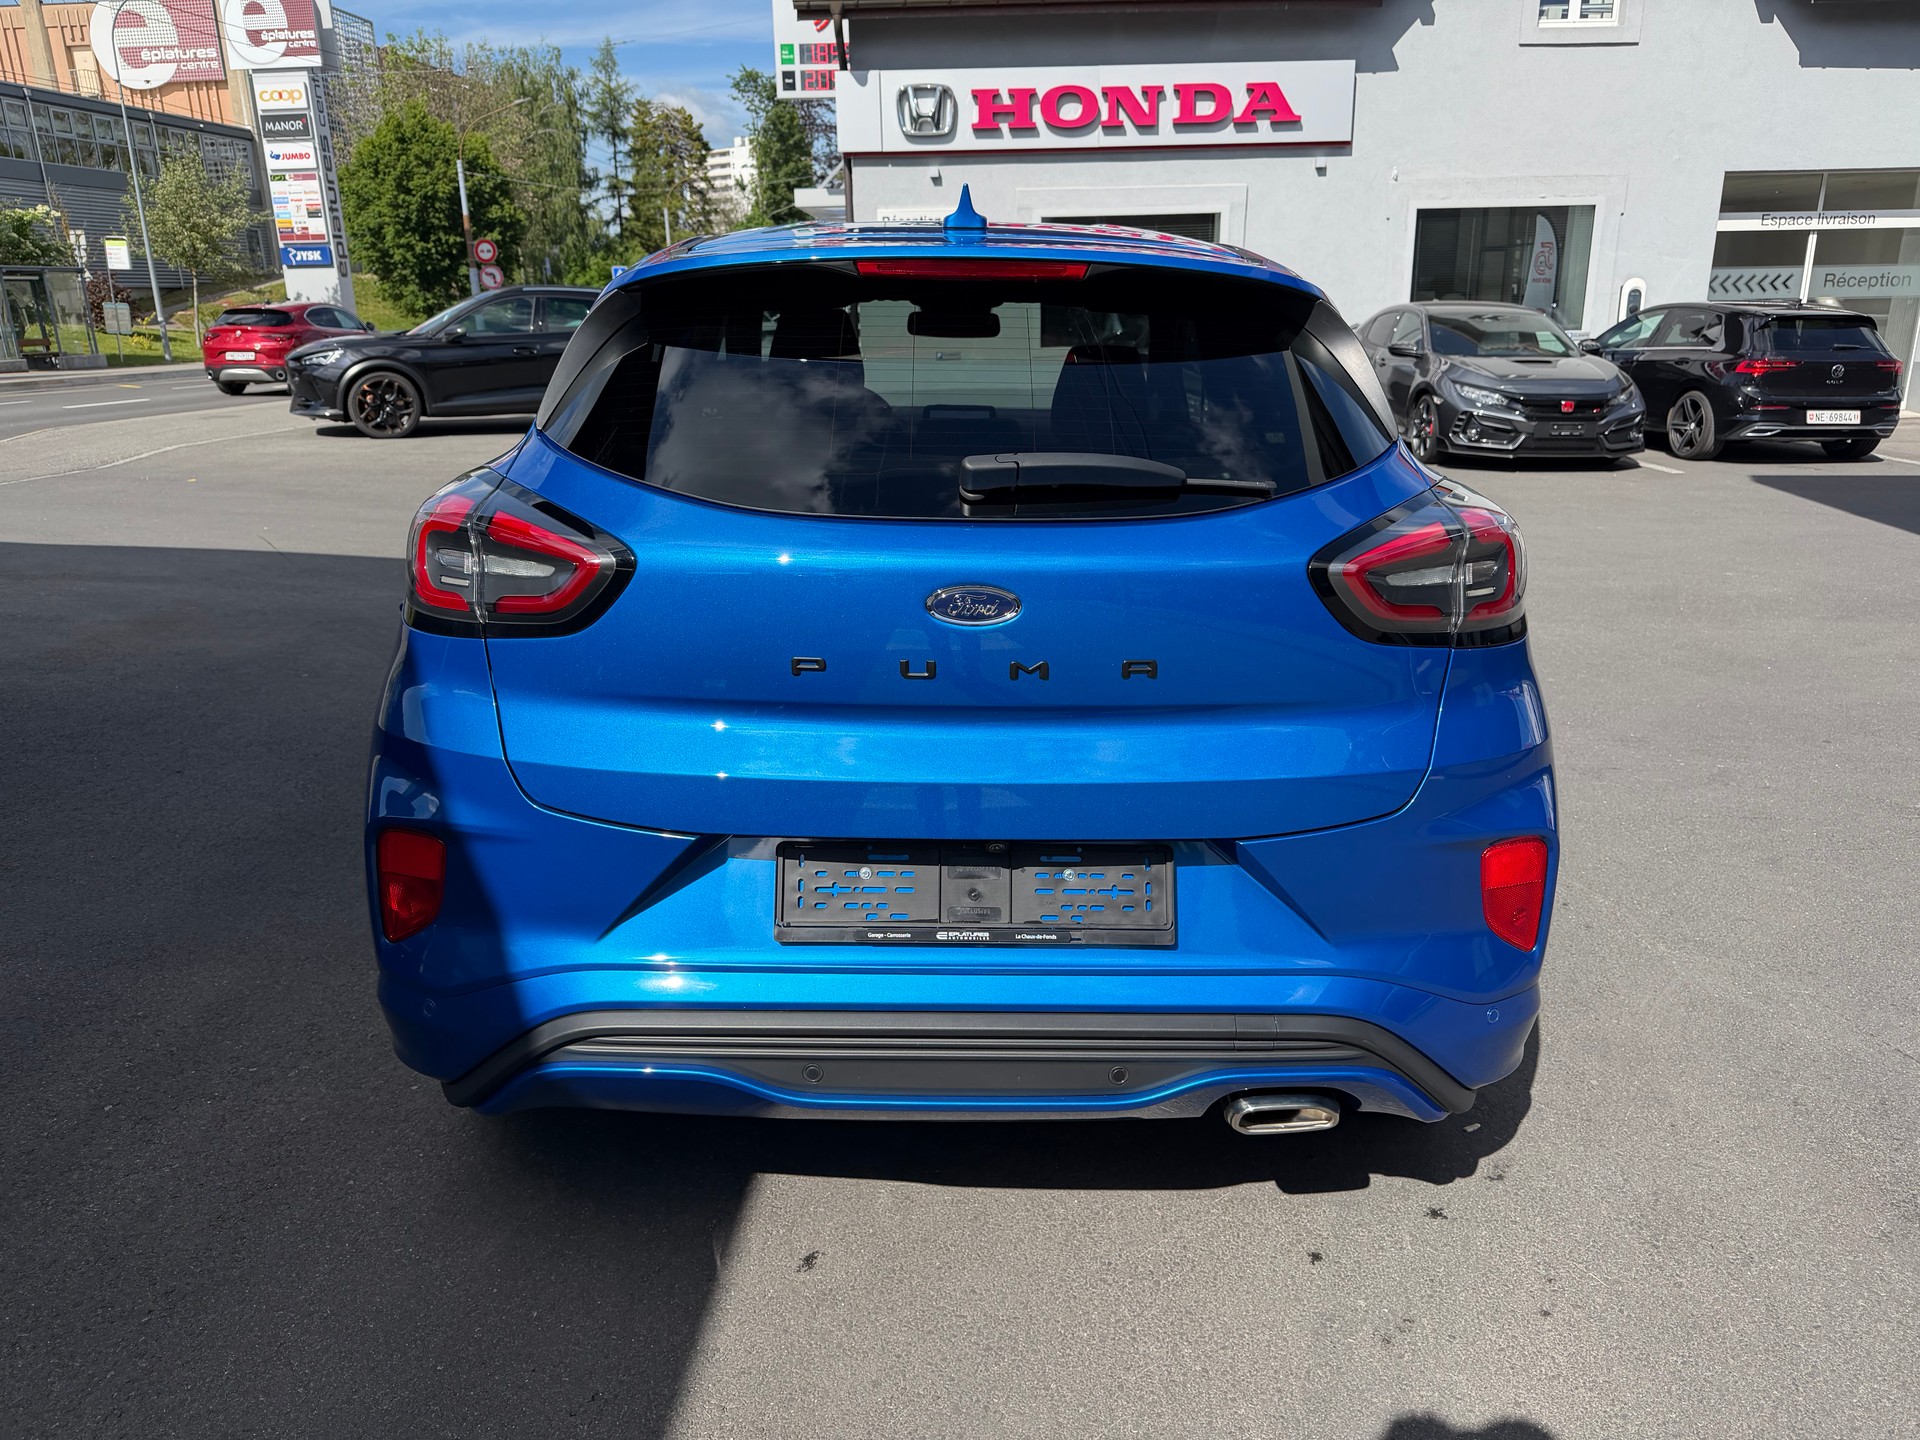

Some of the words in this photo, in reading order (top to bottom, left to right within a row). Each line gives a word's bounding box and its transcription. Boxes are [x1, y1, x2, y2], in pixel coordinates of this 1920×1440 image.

[261, 29, 315, 42] éplatures
[288, 40, 317, 48] centre
[140, 47, 217, 62] éplatures
[180, 60, 218, 70] centre
[259, 89, 303, 104] coop
[971, 81, 1302, 131] HONDA
[265, 120, 304, 131] MANOR
[281, 152, 311, 160] JUMBO
[1760, 213, 1813, 228] Espace
[1817, 212, 1876, 226] livraison
[295, 250, 322, 261] JYSK
[1823, 271, 1912, 290] Réception
